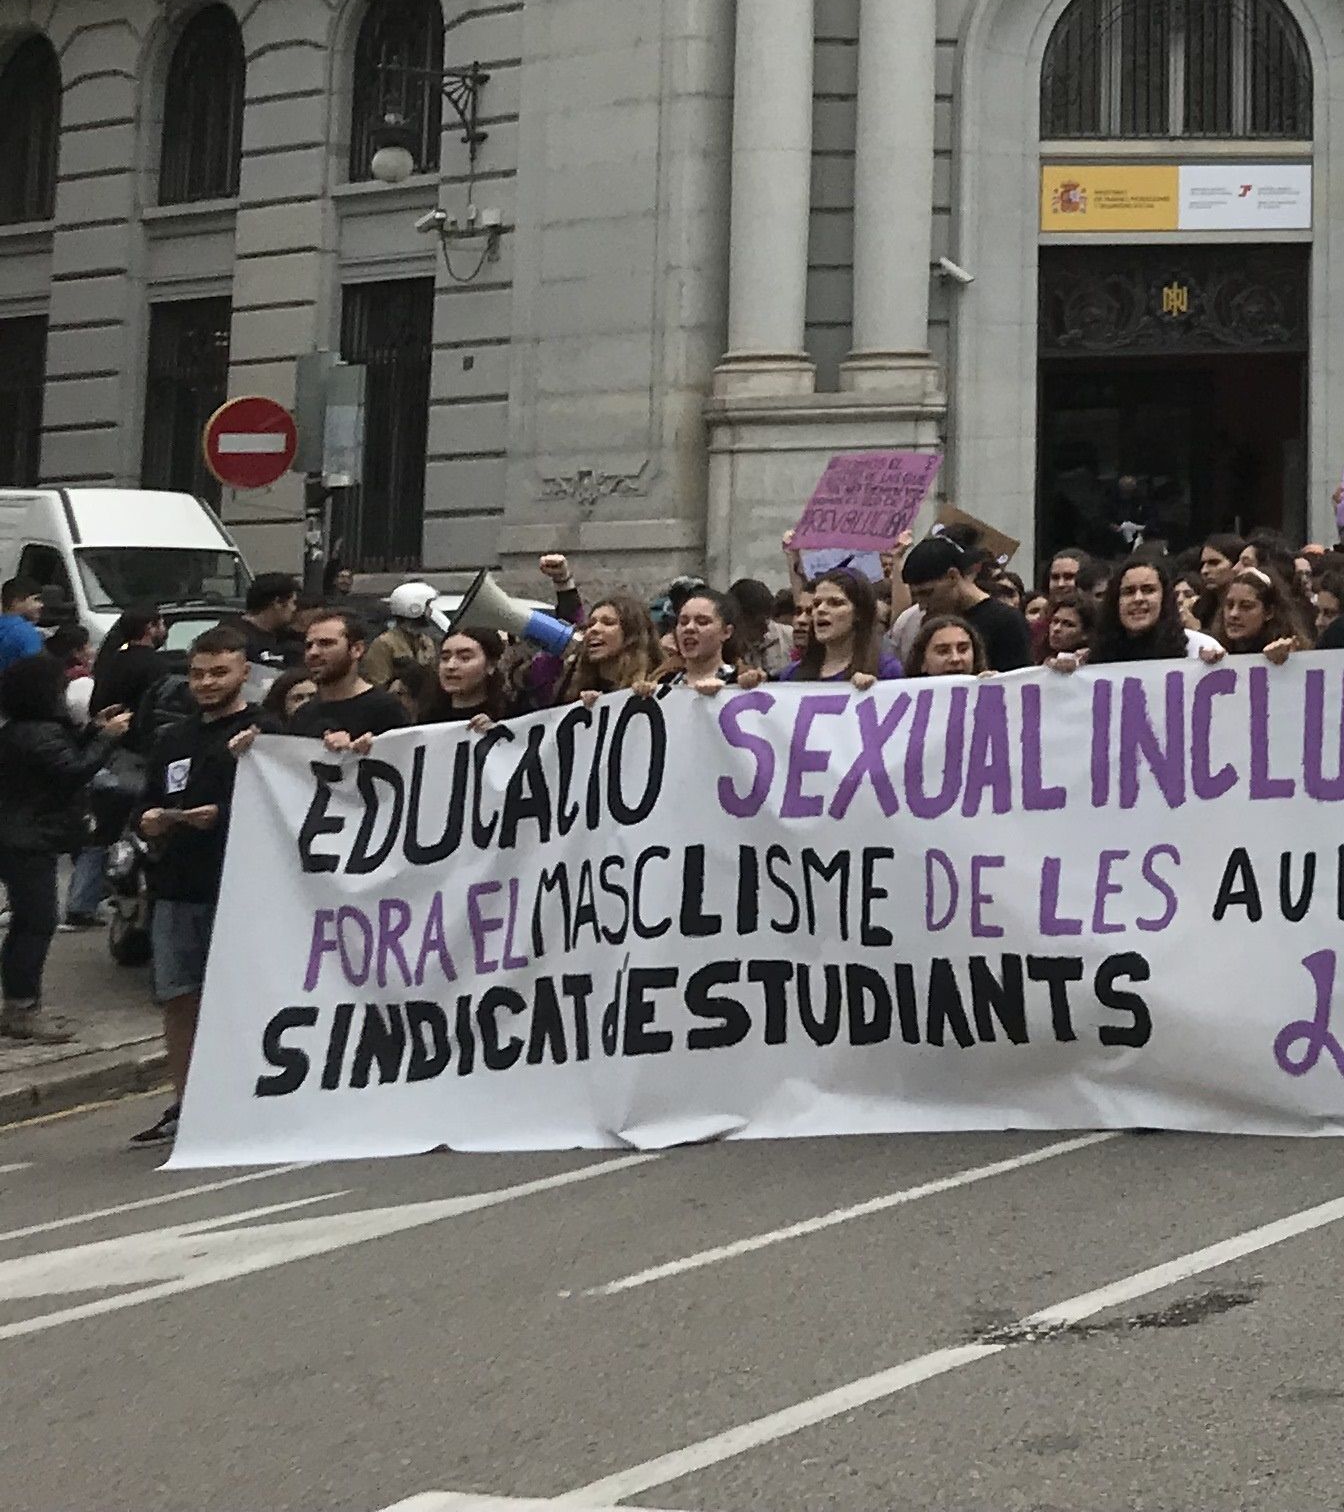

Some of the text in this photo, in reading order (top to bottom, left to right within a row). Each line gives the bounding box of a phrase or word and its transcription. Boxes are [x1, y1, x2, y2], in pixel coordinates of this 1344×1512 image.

[298, 684, 668, 875] EDUCACIÓ
[717, 684, 1067, 819] SEXUAL
[304, 896, 457, 992] FORA
[468, 877, 529, 971] EL
[530, 845, 895, 958] MASCLISME
[925, 849, 1005, 937] DE
[1040, 843, 1180, 937] LES
[254, 973, 594, 1097] SINDICAT
